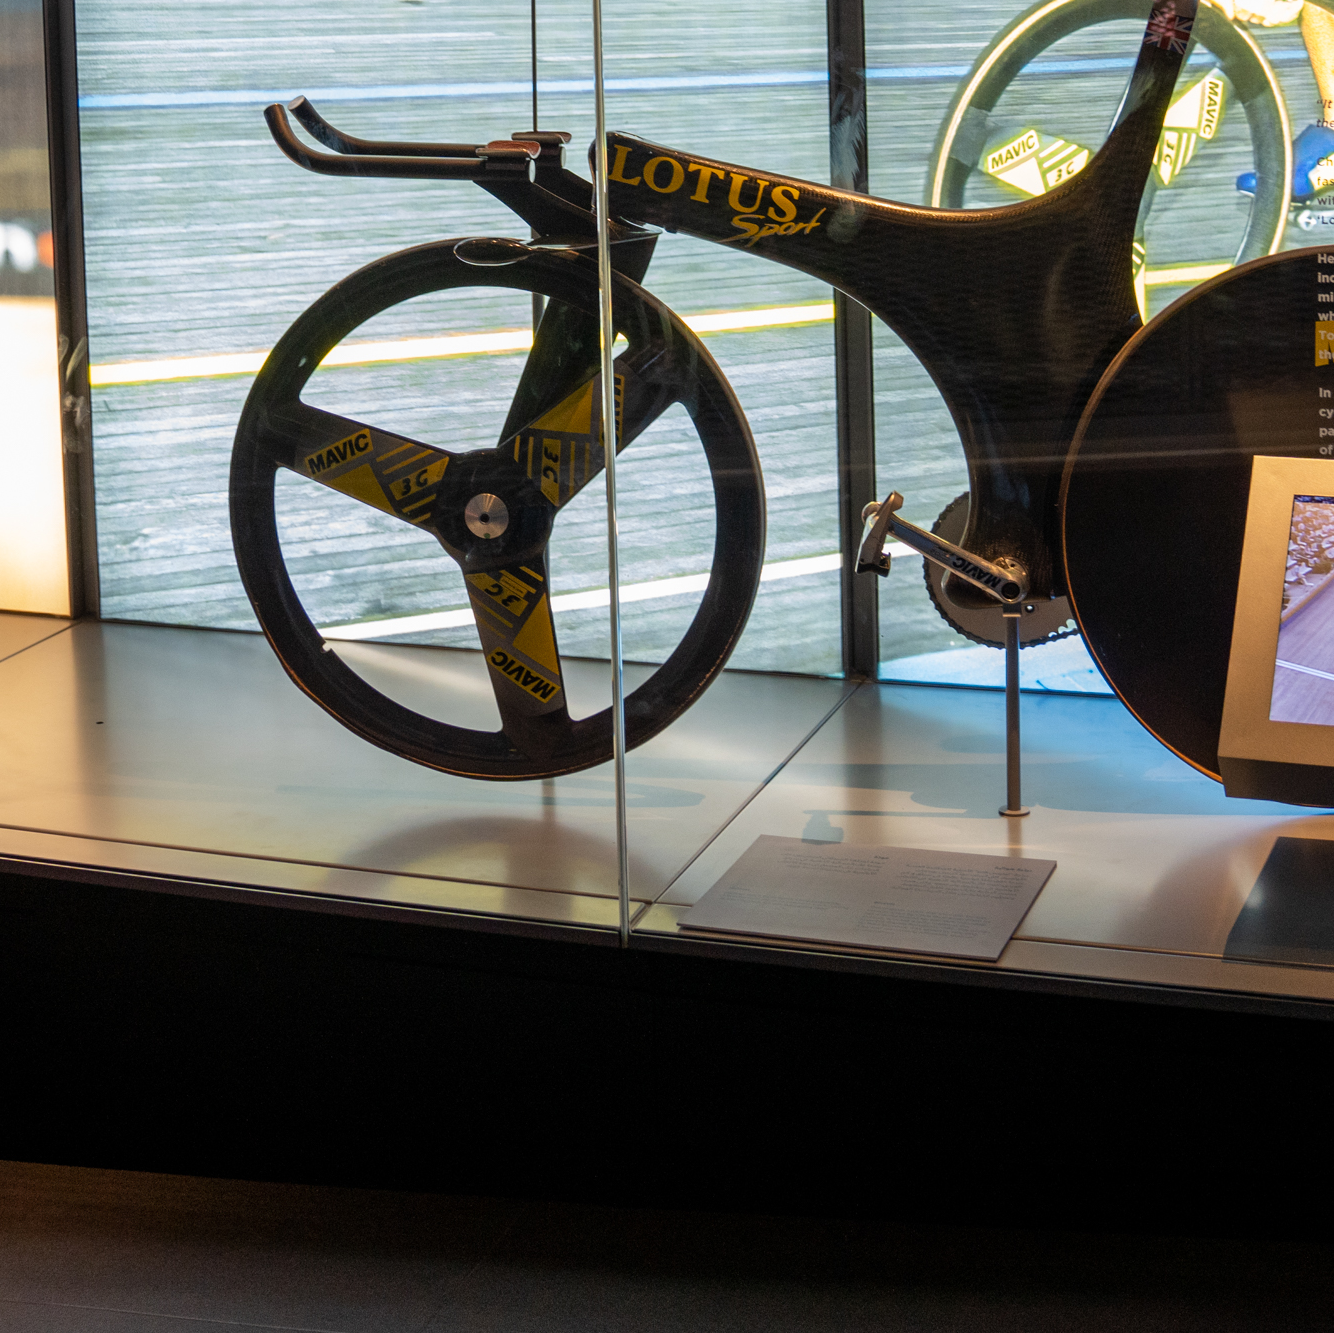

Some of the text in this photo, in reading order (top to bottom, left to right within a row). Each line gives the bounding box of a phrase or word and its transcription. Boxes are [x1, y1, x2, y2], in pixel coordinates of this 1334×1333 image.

[1203, 81, 1220, 137] MAVIC
[991, 134, 1037, 169] MAVIC
[608, 144, 800, 223] LOTUS
[716, 207, 827, 247] Sport
[1319, 387, 1331, 398] In
[308, 432, 370, 477] MAVIC
[1319, 445, 1333, 455] of
[953, 557, 1001, 588] MAVIC
[490, 651, 556, 700] MAVIC
